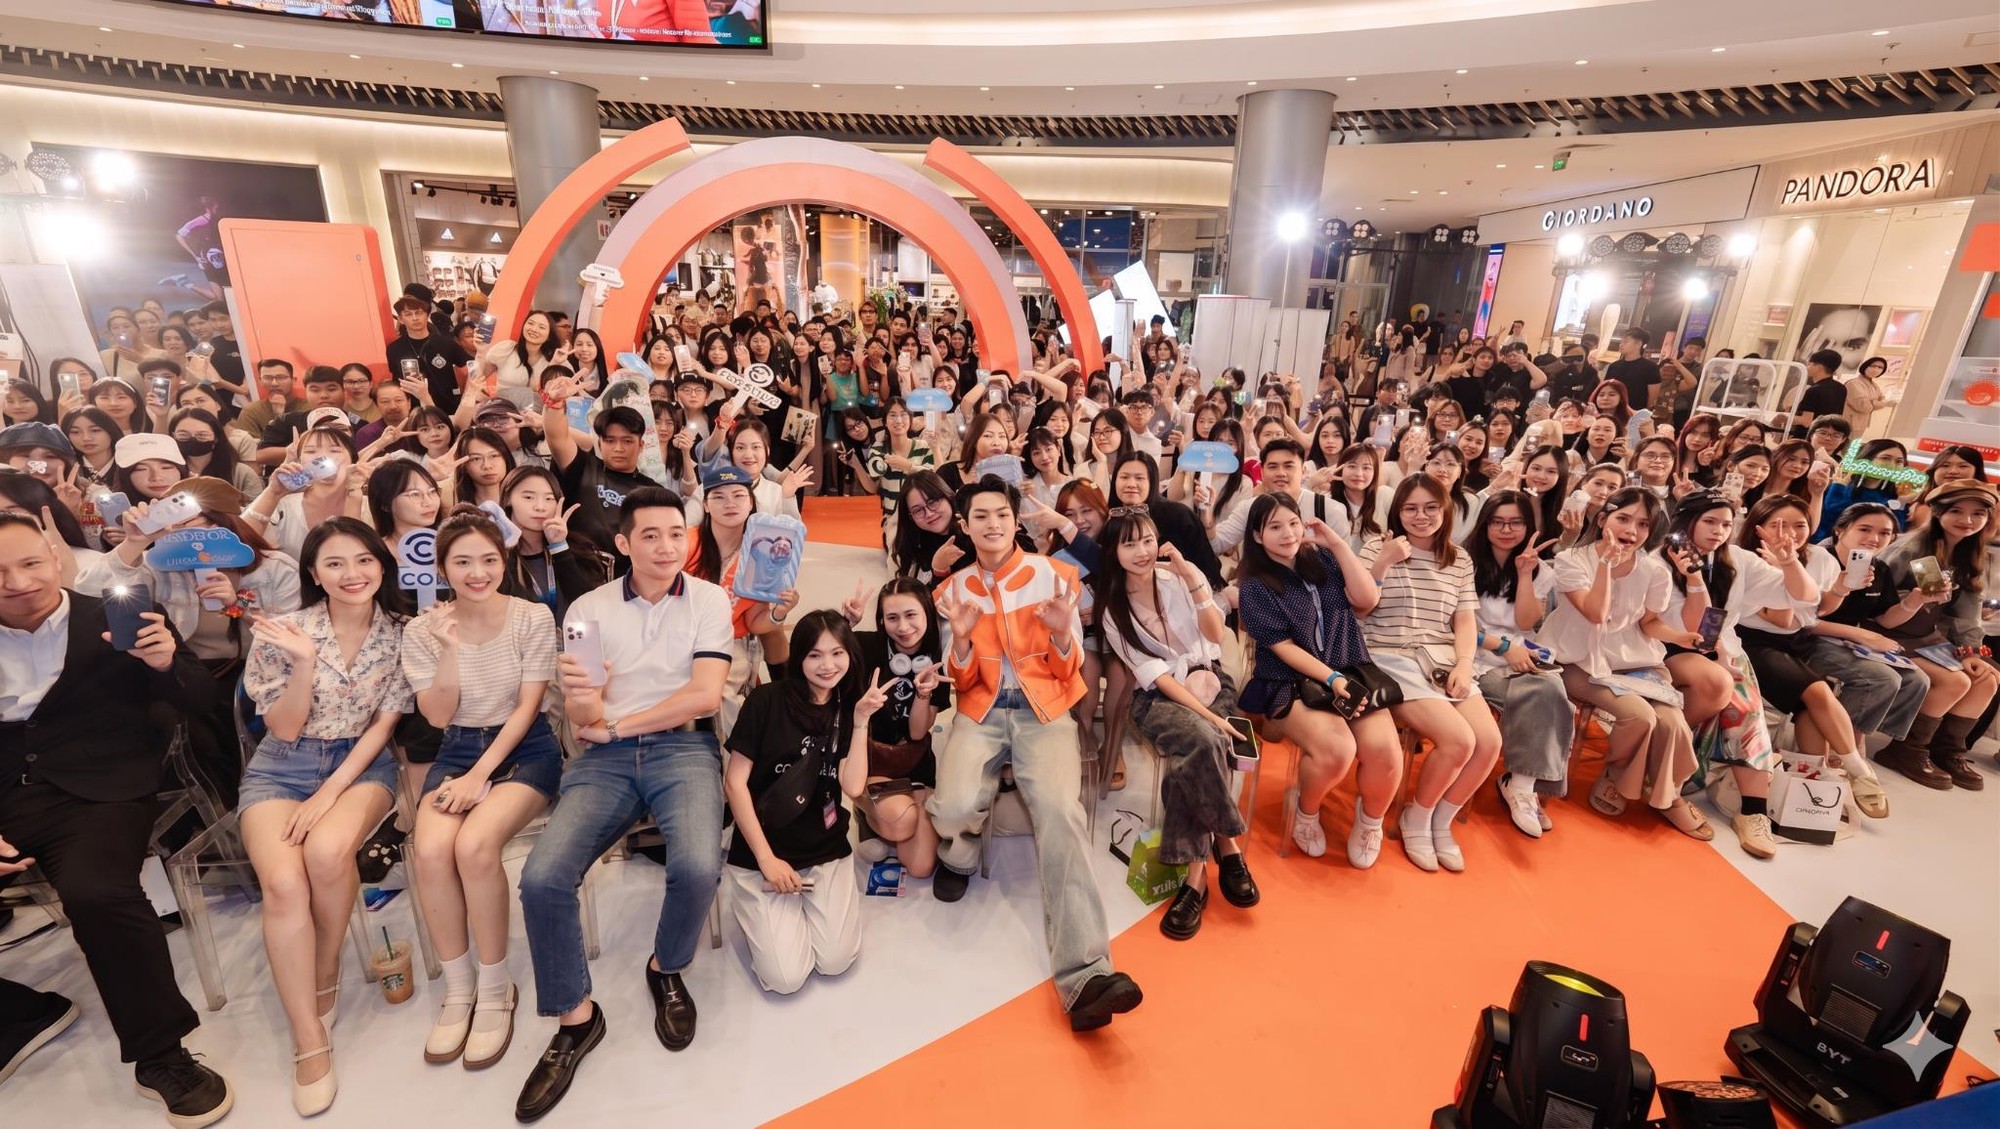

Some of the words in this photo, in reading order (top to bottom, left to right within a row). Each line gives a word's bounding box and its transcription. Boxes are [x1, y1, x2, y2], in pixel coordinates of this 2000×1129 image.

[1780, 158, 1932, 204] PANDORA
[1542, 197, 1654, 231] GIORDANO
[1817, 1042, 1851, 1064] BYT
